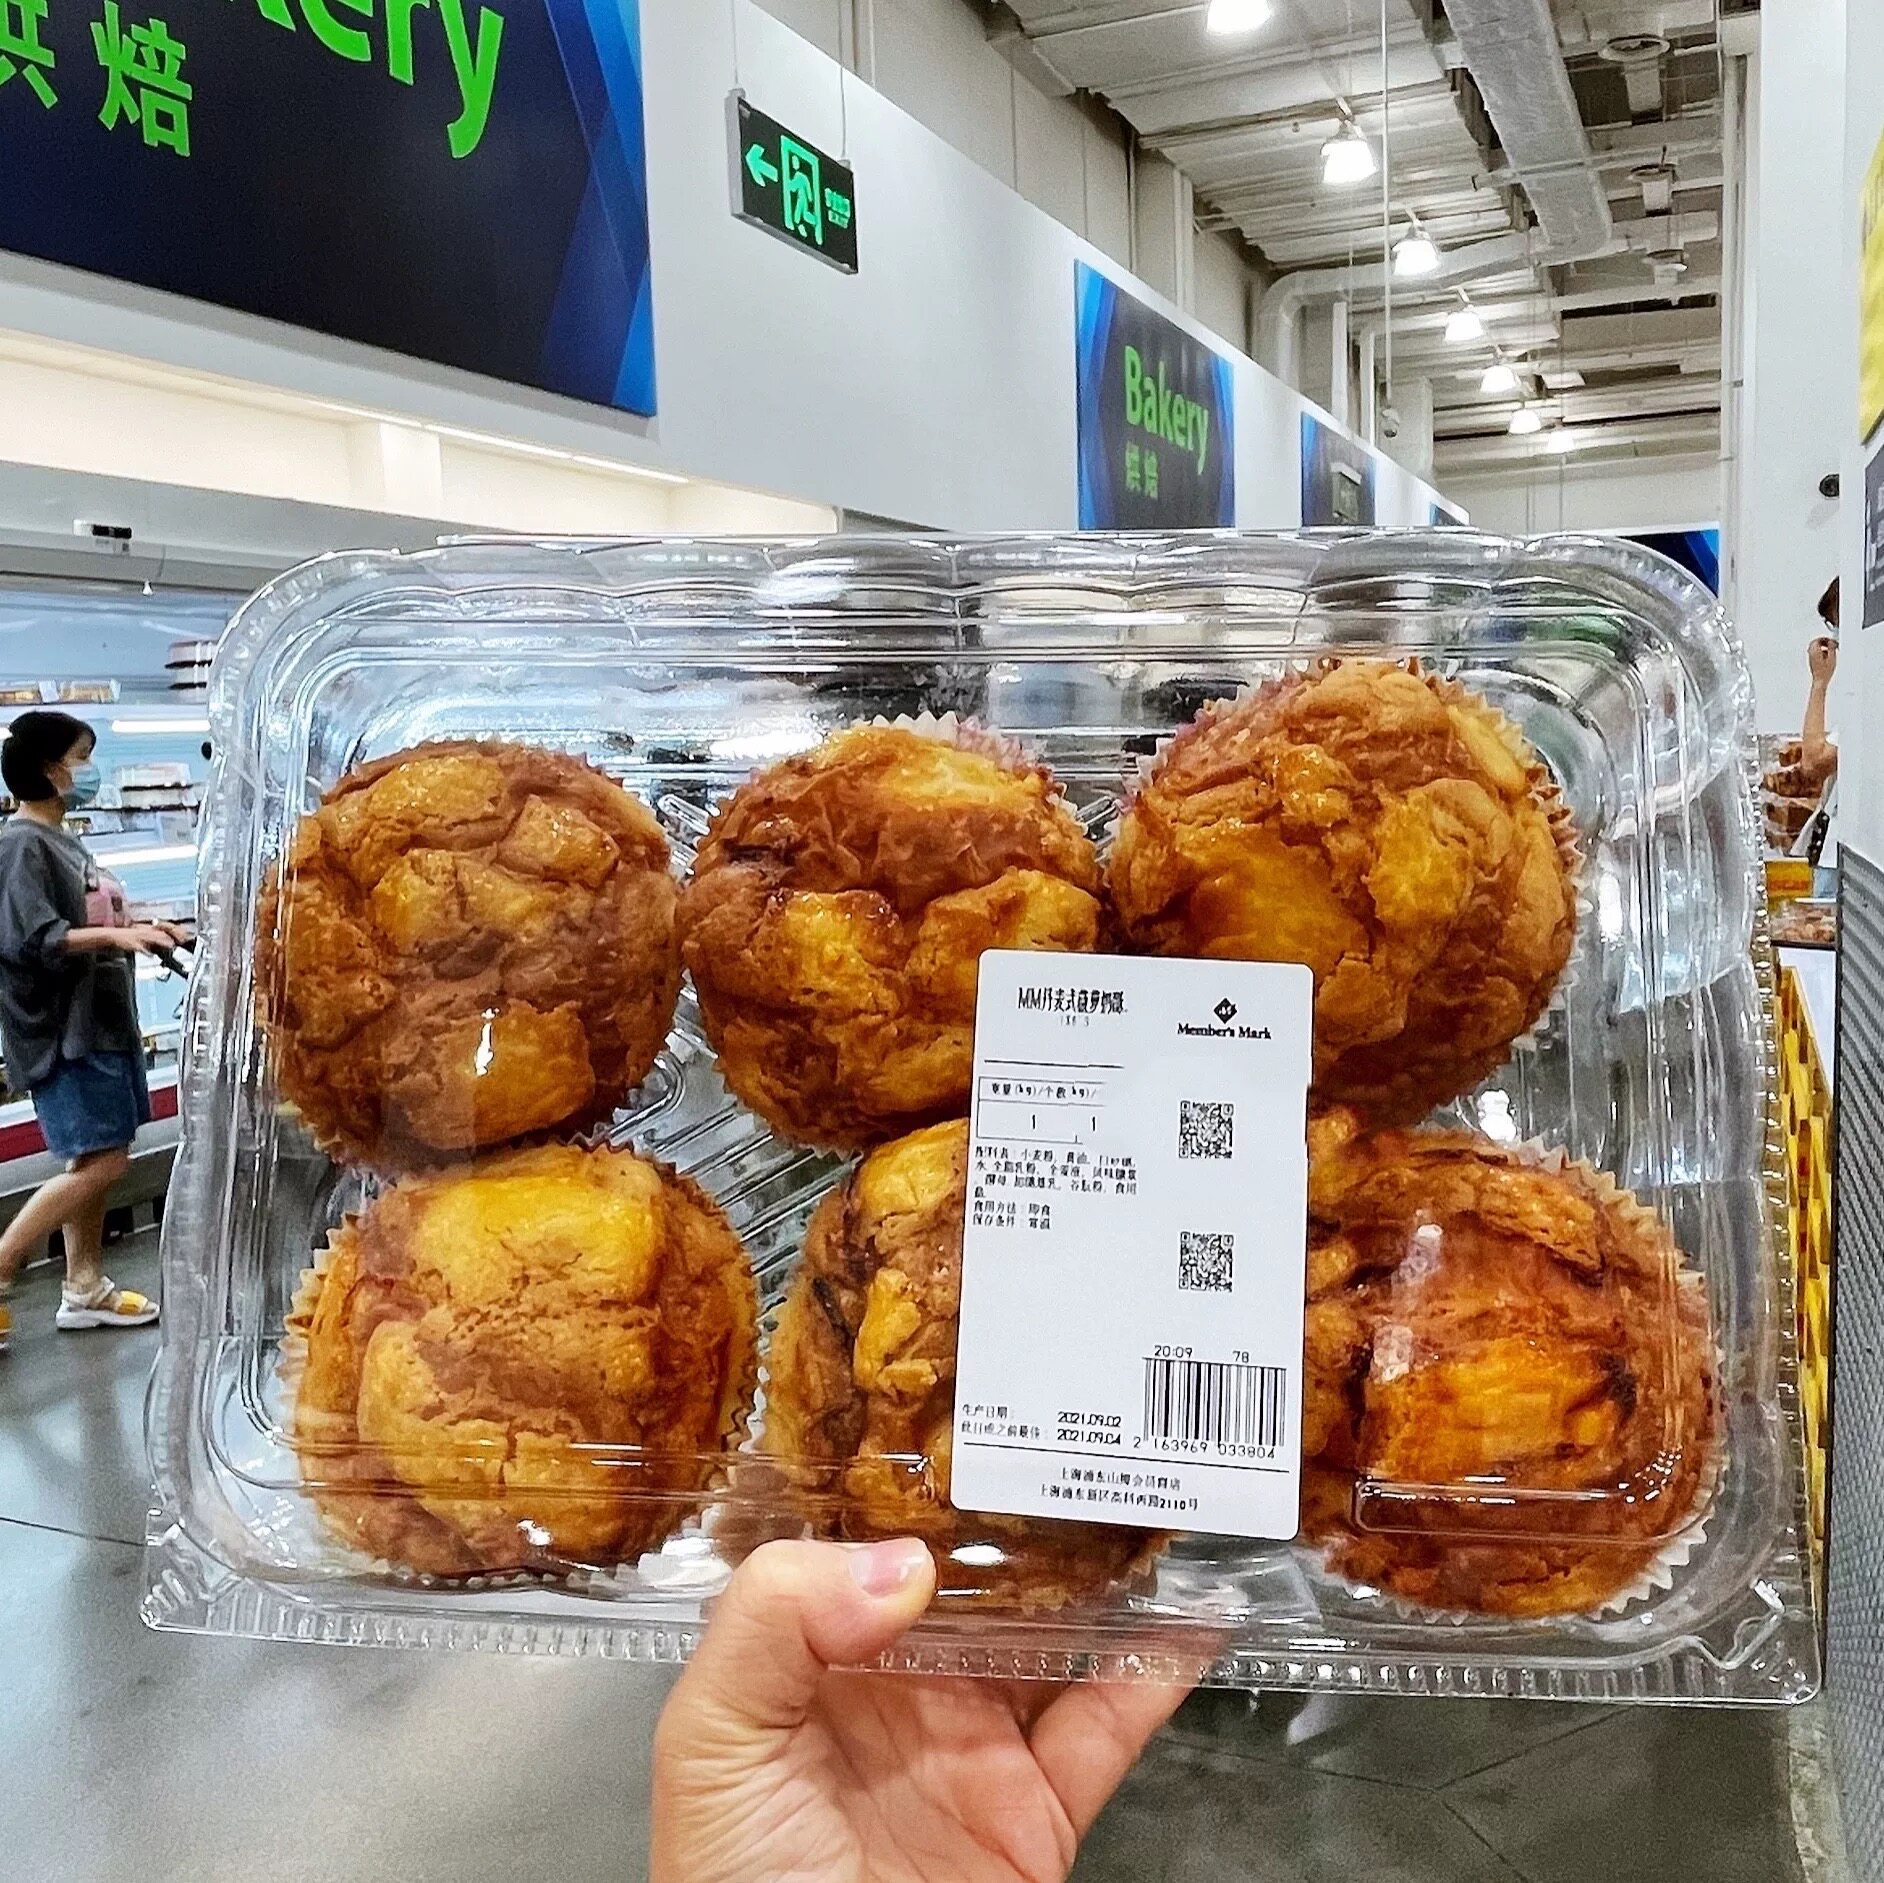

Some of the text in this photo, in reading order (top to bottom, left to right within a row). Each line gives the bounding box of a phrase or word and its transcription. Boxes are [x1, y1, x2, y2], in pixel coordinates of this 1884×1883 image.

[228, 0, 505, 158] ery
[1124, 345, 1208, 475] Bakery
[1178, 1023, 1271, 1039] Member's Mark
[1154, 1345, 1250, 1363] 20:09 78
[1057, 1411, 1121, 1427] 2021.09.02
[1057, 1428, 1121, 1444] 2021.09.04
[1133, 1437, 1275, 1459] 2 163969 033804
